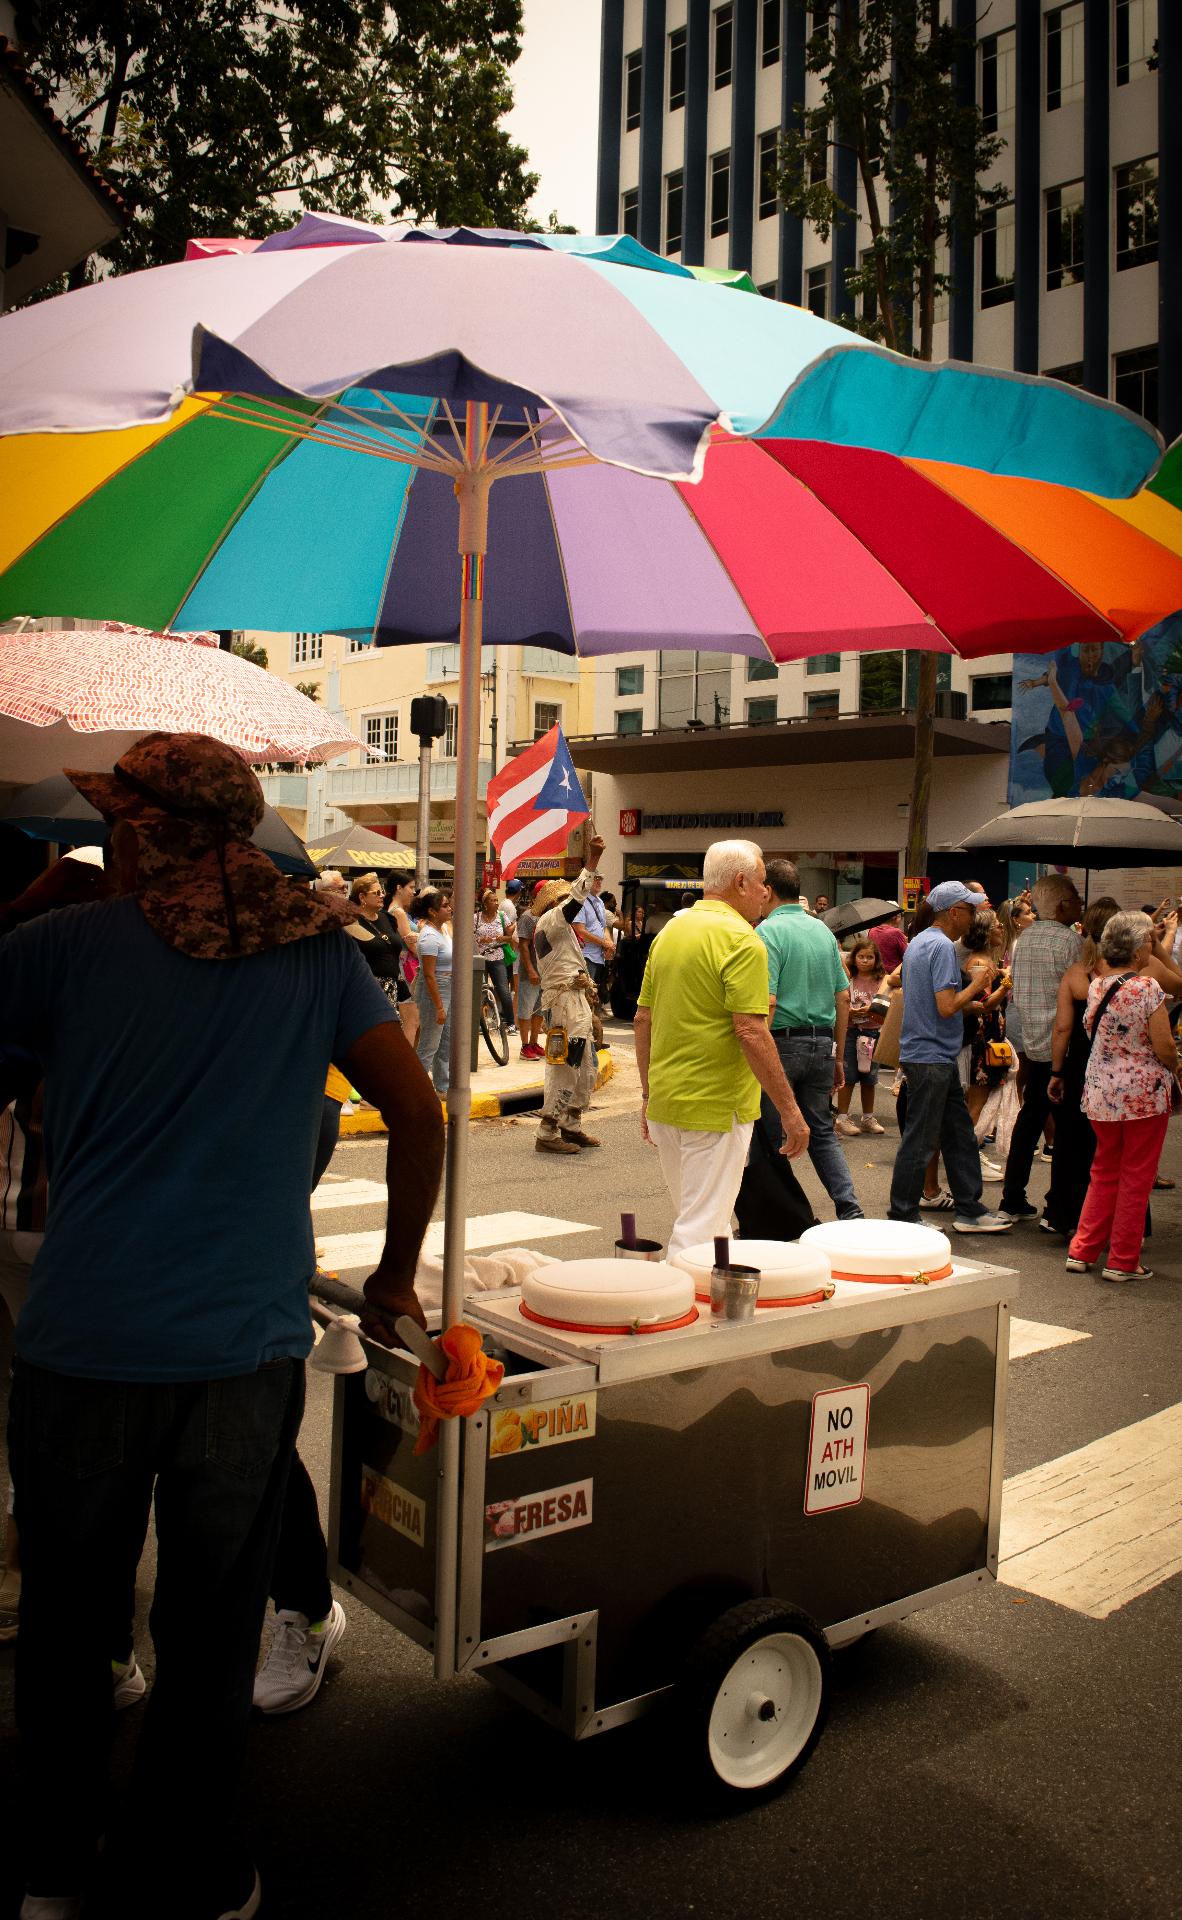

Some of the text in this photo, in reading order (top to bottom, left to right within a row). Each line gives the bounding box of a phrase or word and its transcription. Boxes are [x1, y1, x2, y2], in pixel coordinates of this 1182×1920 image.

[533, 1400, 588, 1440] PIÑA
[828, 1406, 853, 1432] NO
[821, 1437, 854, 1463] ATH
[814, 1465, 857, 1490] MOVIL
[513, 1490, 587, 1534] FRESA
